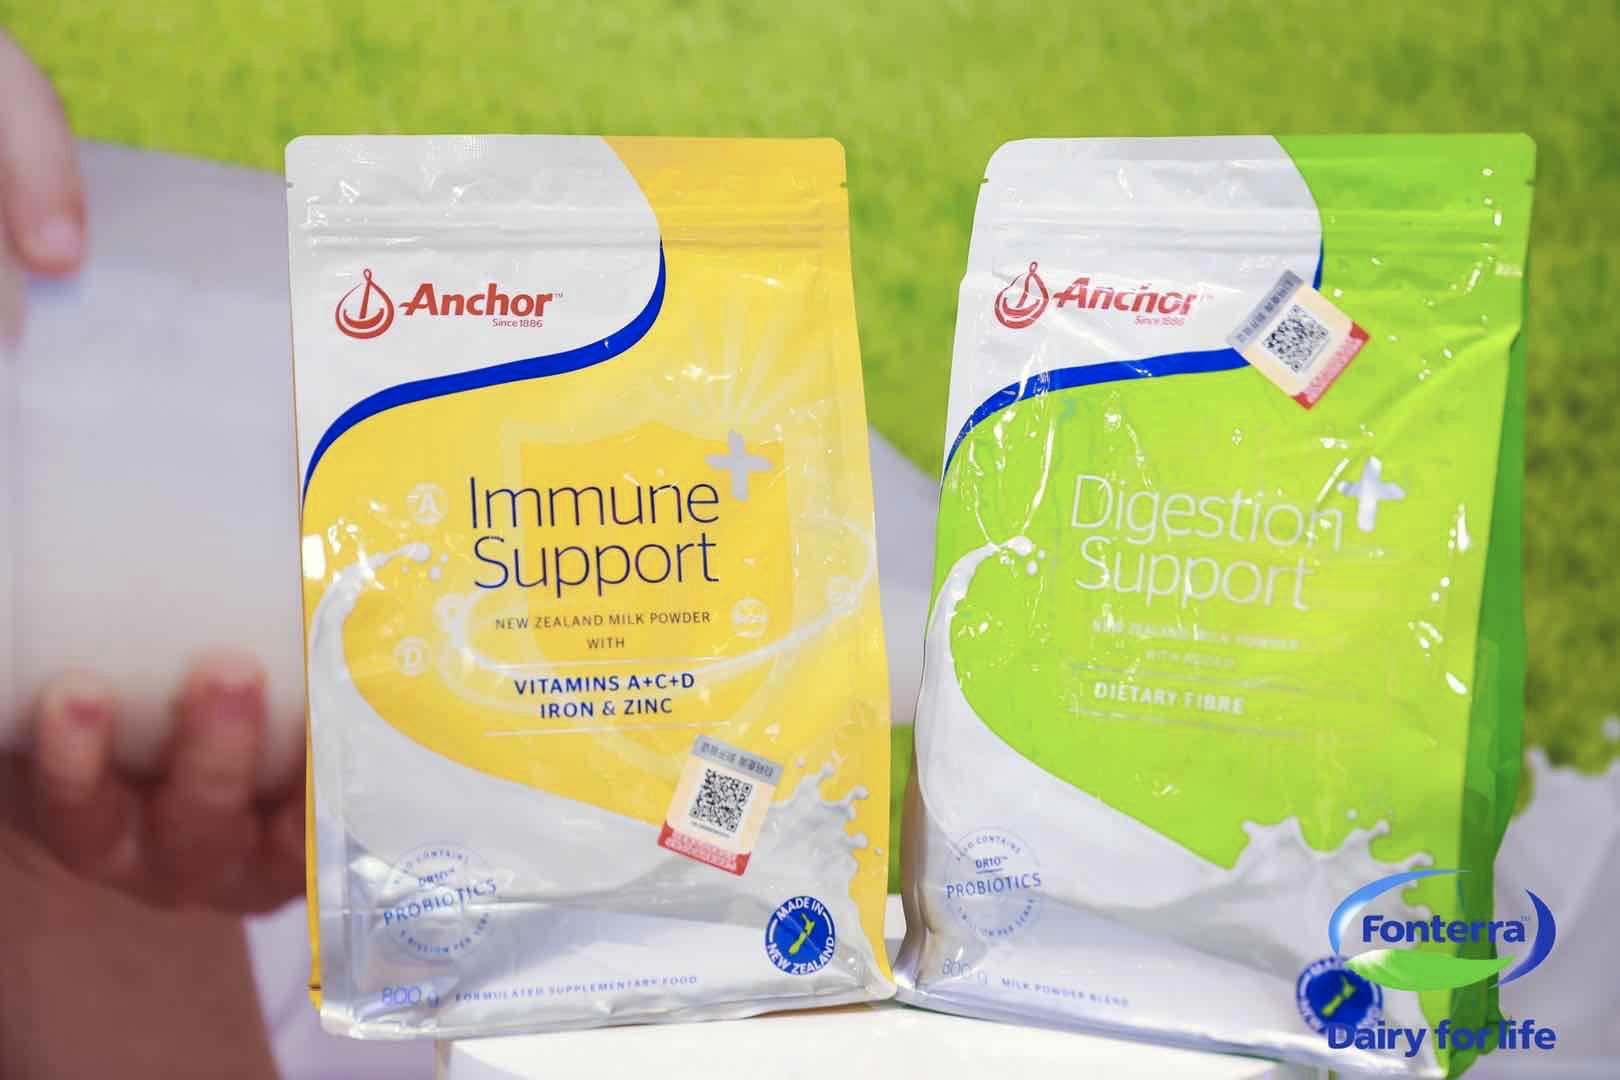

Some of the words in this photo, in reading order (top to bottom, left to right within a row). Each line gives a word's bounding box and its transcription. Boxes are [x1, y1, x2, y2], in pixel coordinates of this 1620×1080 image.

[492, 318, 518, 327] Since
[520, 319, 543, 328] 1886
[469, 476, 720, 528] Immune
[1072, 474, 1344, 551] Digestion
[474, 532, 720, 598] Support
[1075, 535, 1313, 611] Support
[495, 617, 528, 630] NEW
[535, 615, 604, 629] ZEALAND
[608, 612, 645, 626] MILK
[650, 611, 711, 624] POWDER
[587, 637, 625, 649] WITH
[513, 675, 620, 695] VITAMINS
[627, 672, 695, 691] A+C+D
[540, 702, 594, 719] IRON
[602, 700, 616, 716] &
[623, 698, 673, 715] ZINC
[1094, 681, 1179, 705] DIETARY
[1183, 691, 1247, 715] FIBRE
[946, 872, 1042, 898] PROBIOTICS
[383, 878, 497, 927] PROBIOTICS
[776, 896, 810, 921] MADE
[811, 898, 825, 917] IN
[767, 943, 791, 971] NEW
[791, 936, 835, 976] ZEALAND
[550, 978, 658, 996] SUPPLEMENTARY
[661, 975, 697, 986] FOOD
[1001, 977, 1030, 990] MILK
[1034, 983, 1085, 999] POWDER
